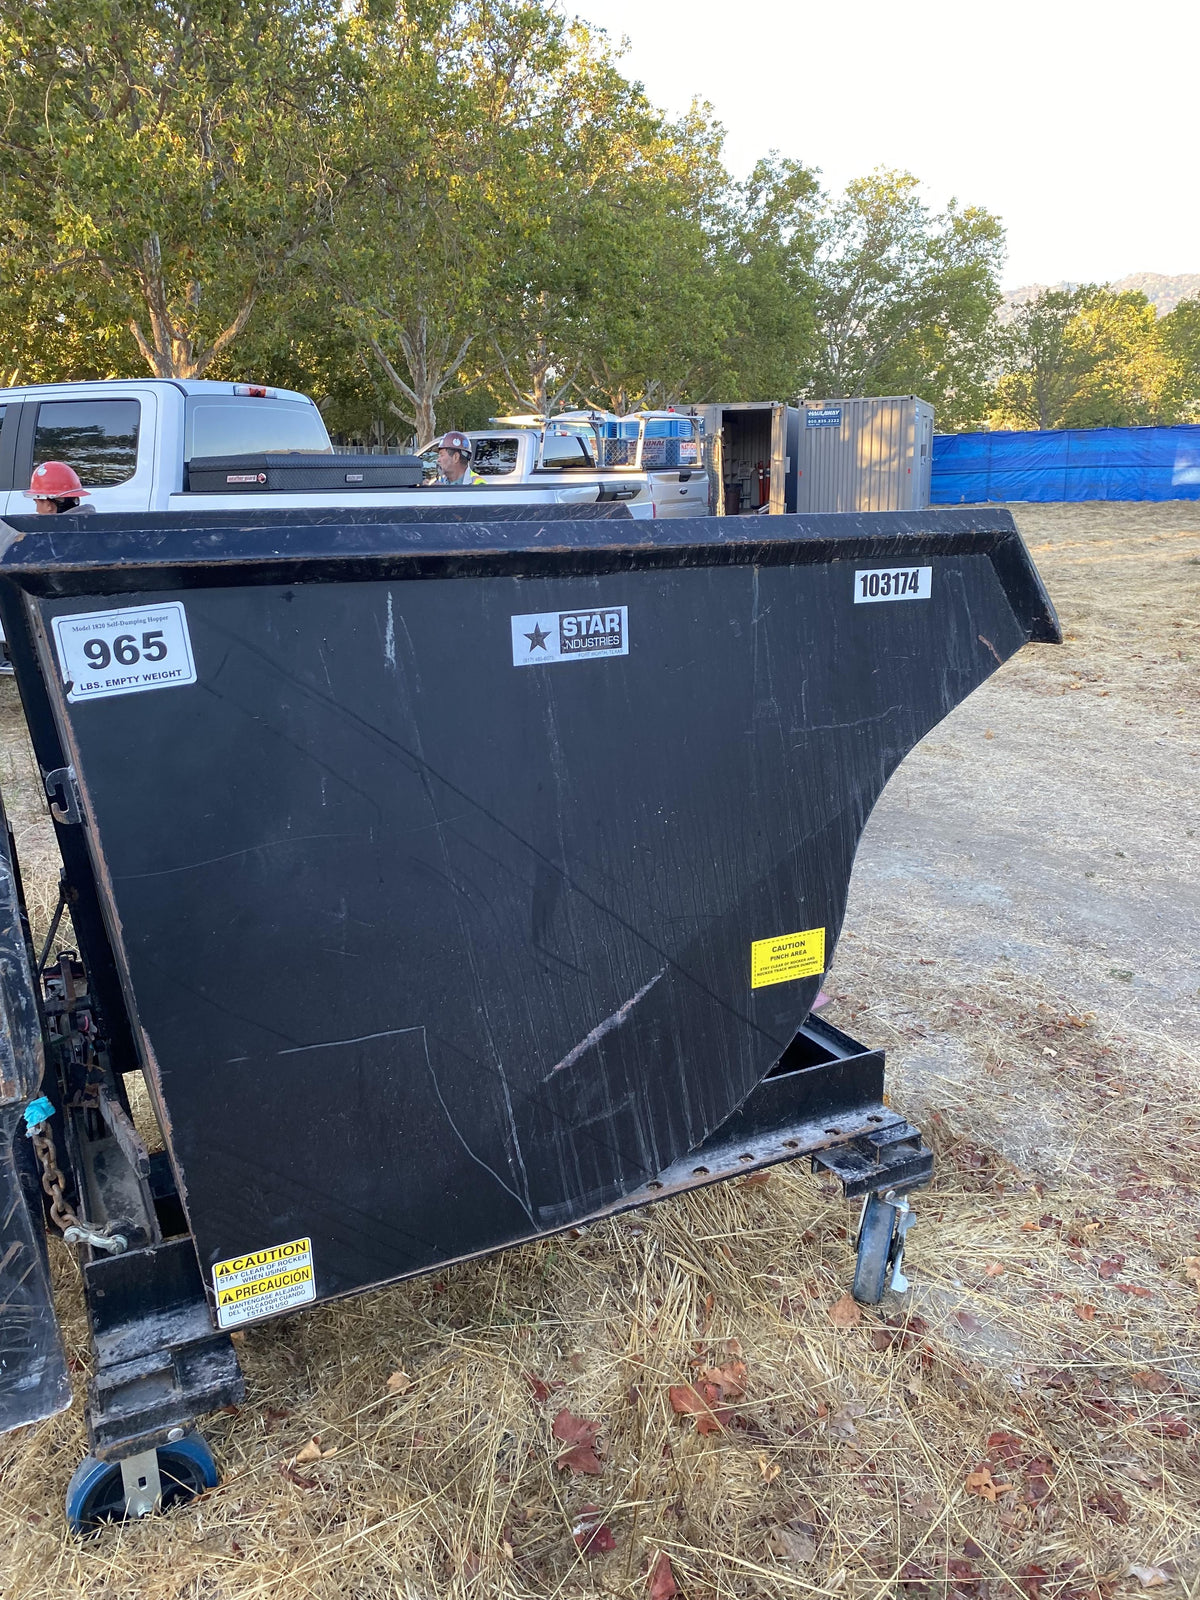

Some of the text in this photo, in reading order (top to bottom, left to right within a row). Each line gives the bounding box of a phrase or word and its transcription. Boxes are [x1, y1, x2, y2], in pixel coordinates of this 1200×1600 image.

[860, 569, 919, 597] 103174
[72, 624, 91, 632] Model
[107, 618, 147, 627] Self-Dumping
[147, 615, 169, 624] Hopper
[562, 613, 620, 637] STAR
[83, 630, 168, 670] 965
[80, 669, 183, 691] LBS. EMPTY WEIGHT
[770, 949, 807, 961] PINCH AREA
[772, 940, 806, 953] CAUTION
[233, 1241, 307, 1271] CAUTION
[220, 1274, 239, 1284] STAY
[240, 1266, 265, 1277] CLEAR
[278, 1254, 308, 1267] ROCKER
[242, 1266, 287, 1283] WHEN USING
[235, 1268, 309, 1300] PRECAUCIÓN
[274, 1284, 304, 1297] ALEJADO
[228, 1290, 306, 1317] DEL VOLCADOR CUANDO
[275, 1300, 289, 1308] USO
